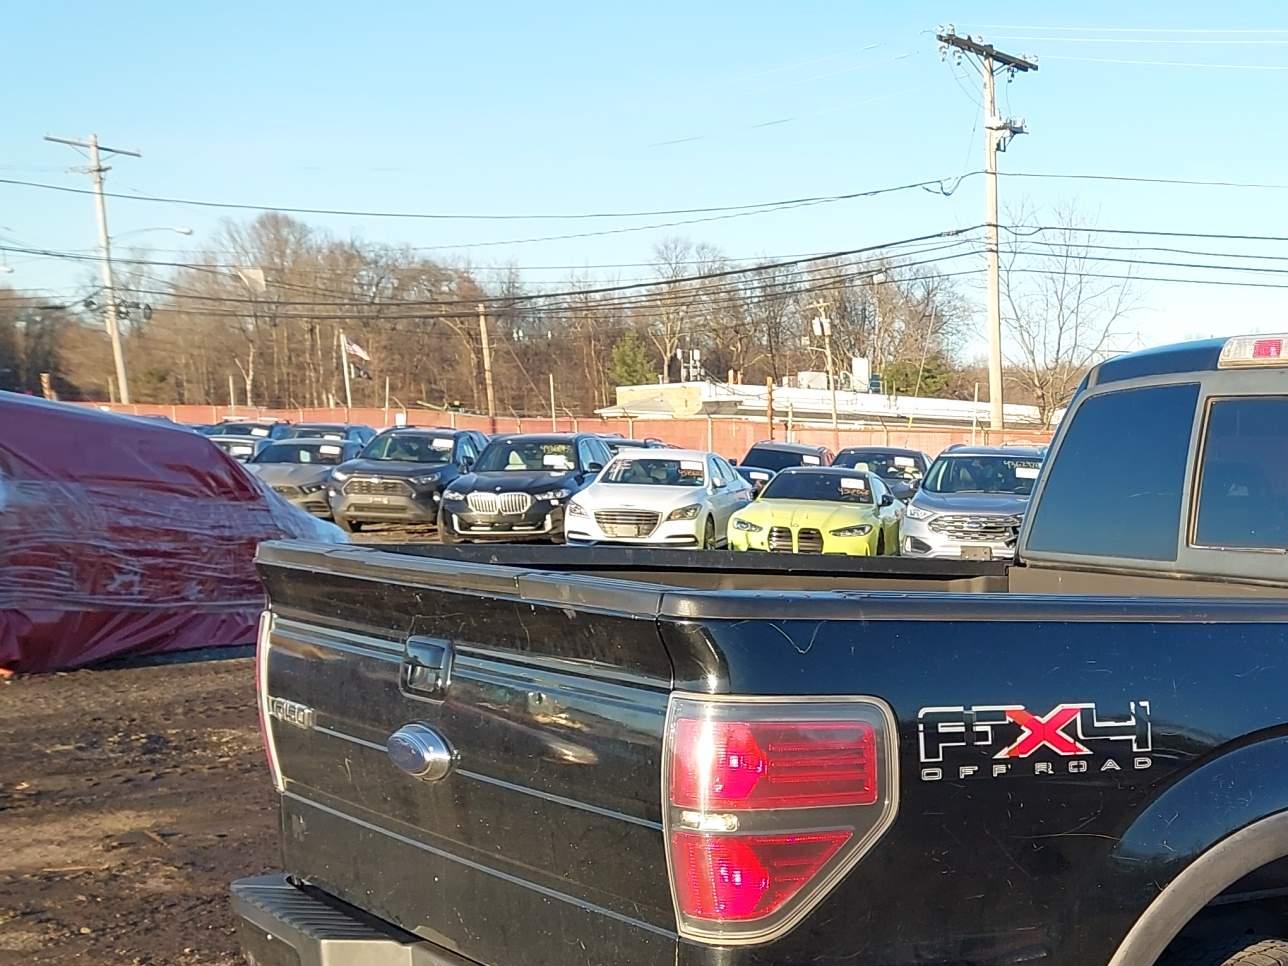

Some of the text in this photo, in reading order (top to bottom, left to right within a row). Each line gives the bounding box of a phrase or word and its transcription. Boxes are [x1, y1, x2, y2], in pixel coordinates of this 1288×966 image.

[917, 701, 1152, 762] FX4
[920, 756, 1152, 781] OFF ROAD
